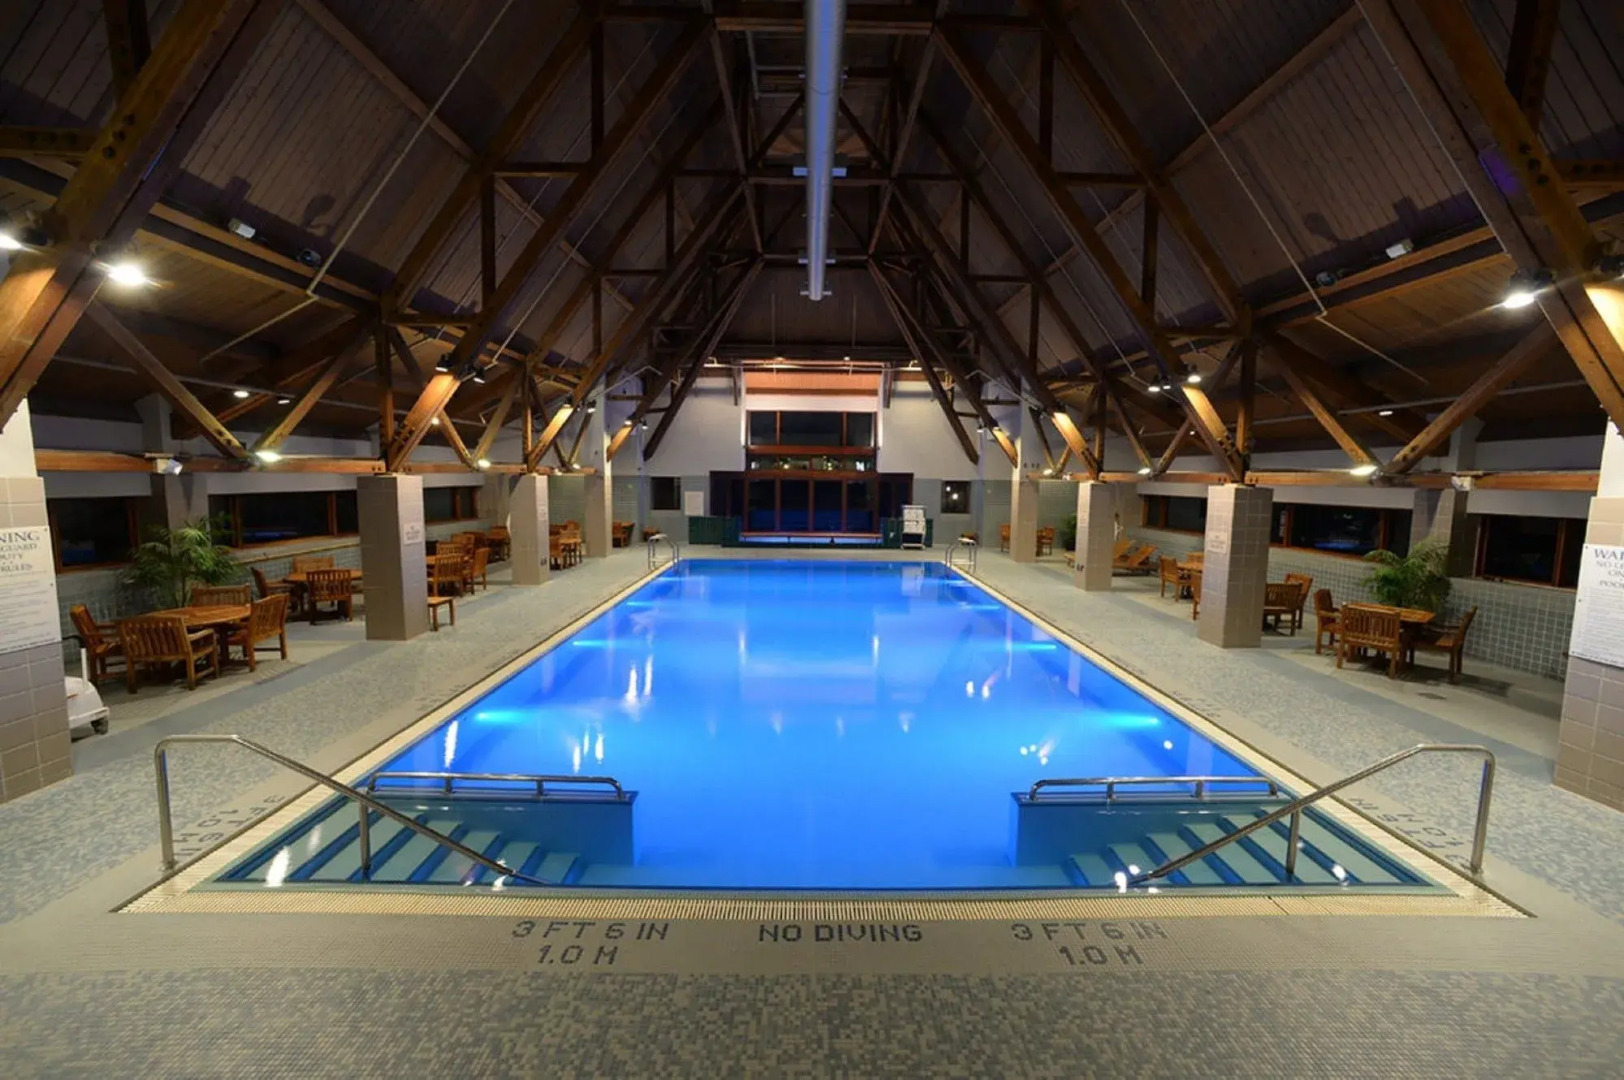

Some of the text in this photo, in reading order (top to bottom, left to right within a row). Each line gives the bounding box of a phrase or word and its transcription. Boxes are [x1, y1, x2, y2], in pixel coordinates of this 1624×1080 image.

[512, 920, 669, 941] 3 FT 6 IN
[758, 924, 923, 943] NO DIVING
[1010, 921, 1169, 941] 3 FT 6 IN
[537, 944, 619, 966] 1.0 M
[1058, 945, 1145, 966] 1.0 M
